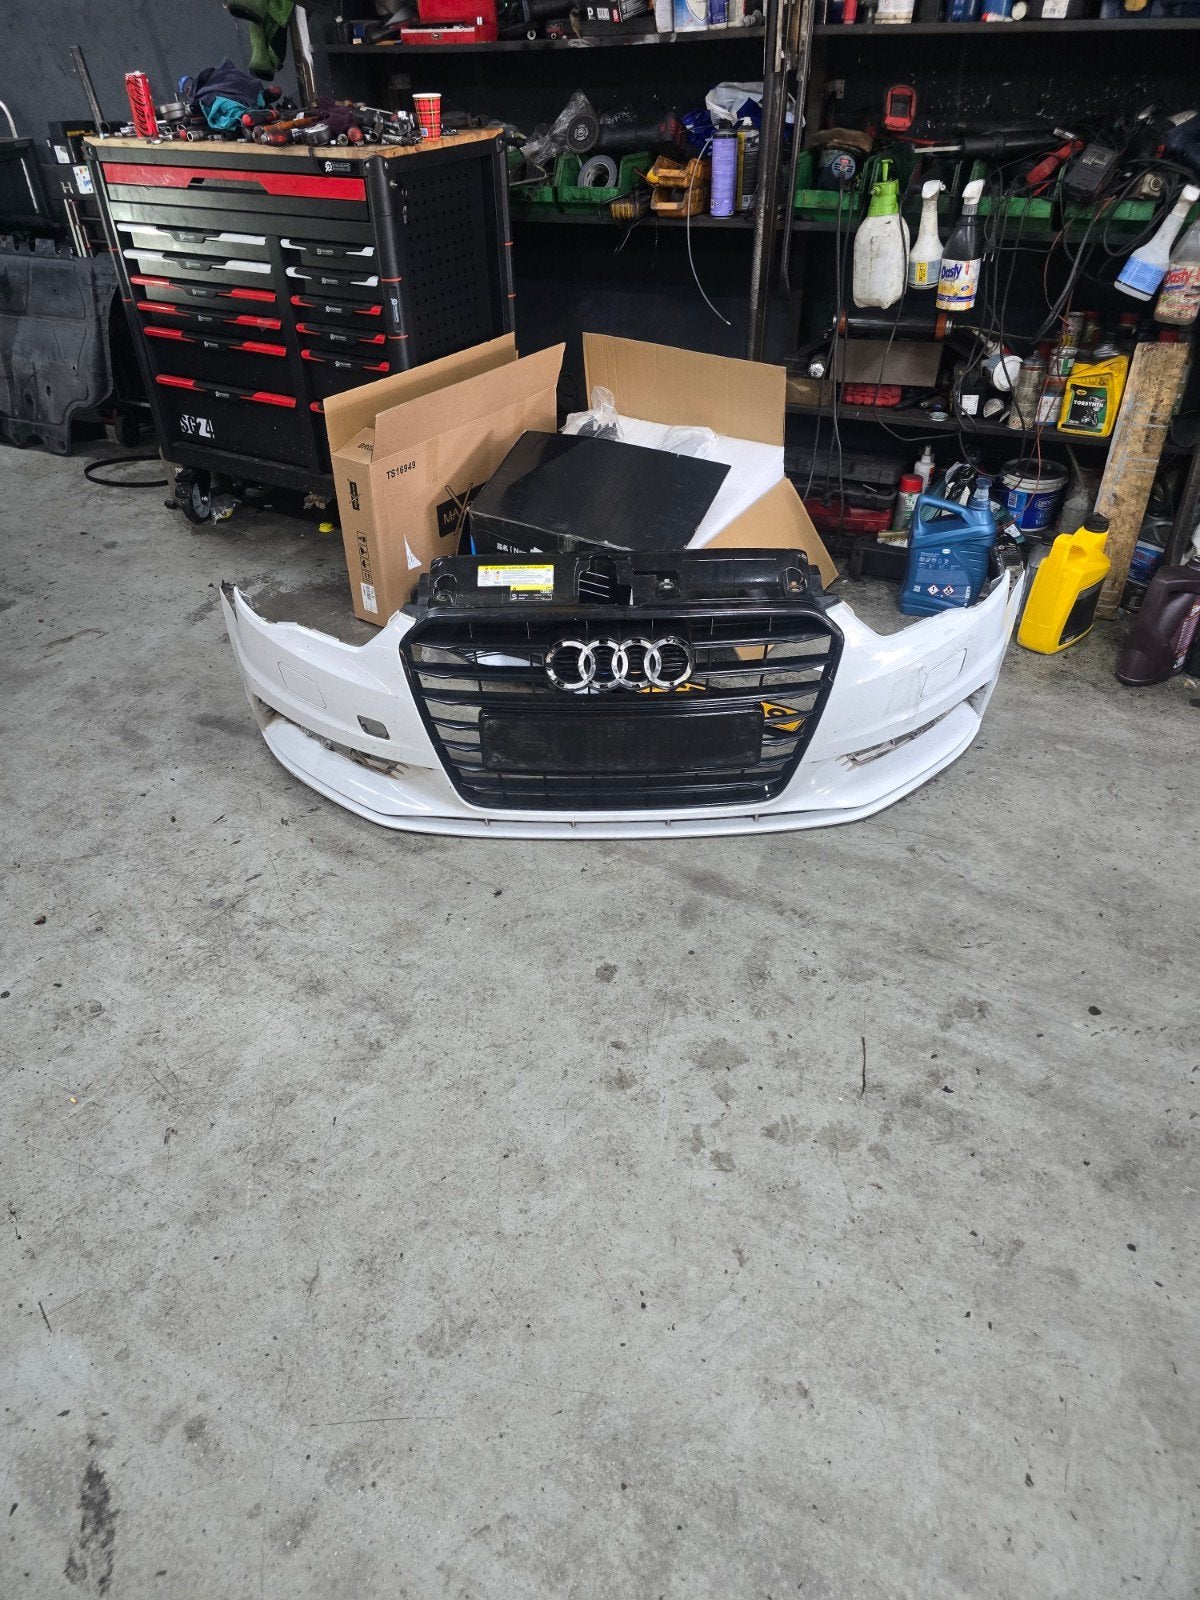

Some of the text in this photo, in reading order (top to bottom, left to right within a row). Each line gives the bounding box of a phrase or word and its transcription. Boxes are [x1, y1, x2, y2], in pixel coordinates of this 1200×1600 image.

[941, 264, 962, 280] Dasty
[1073, 400, 1104, 408] TORSYNTH
[385, 461, 416, 480] TS16949
